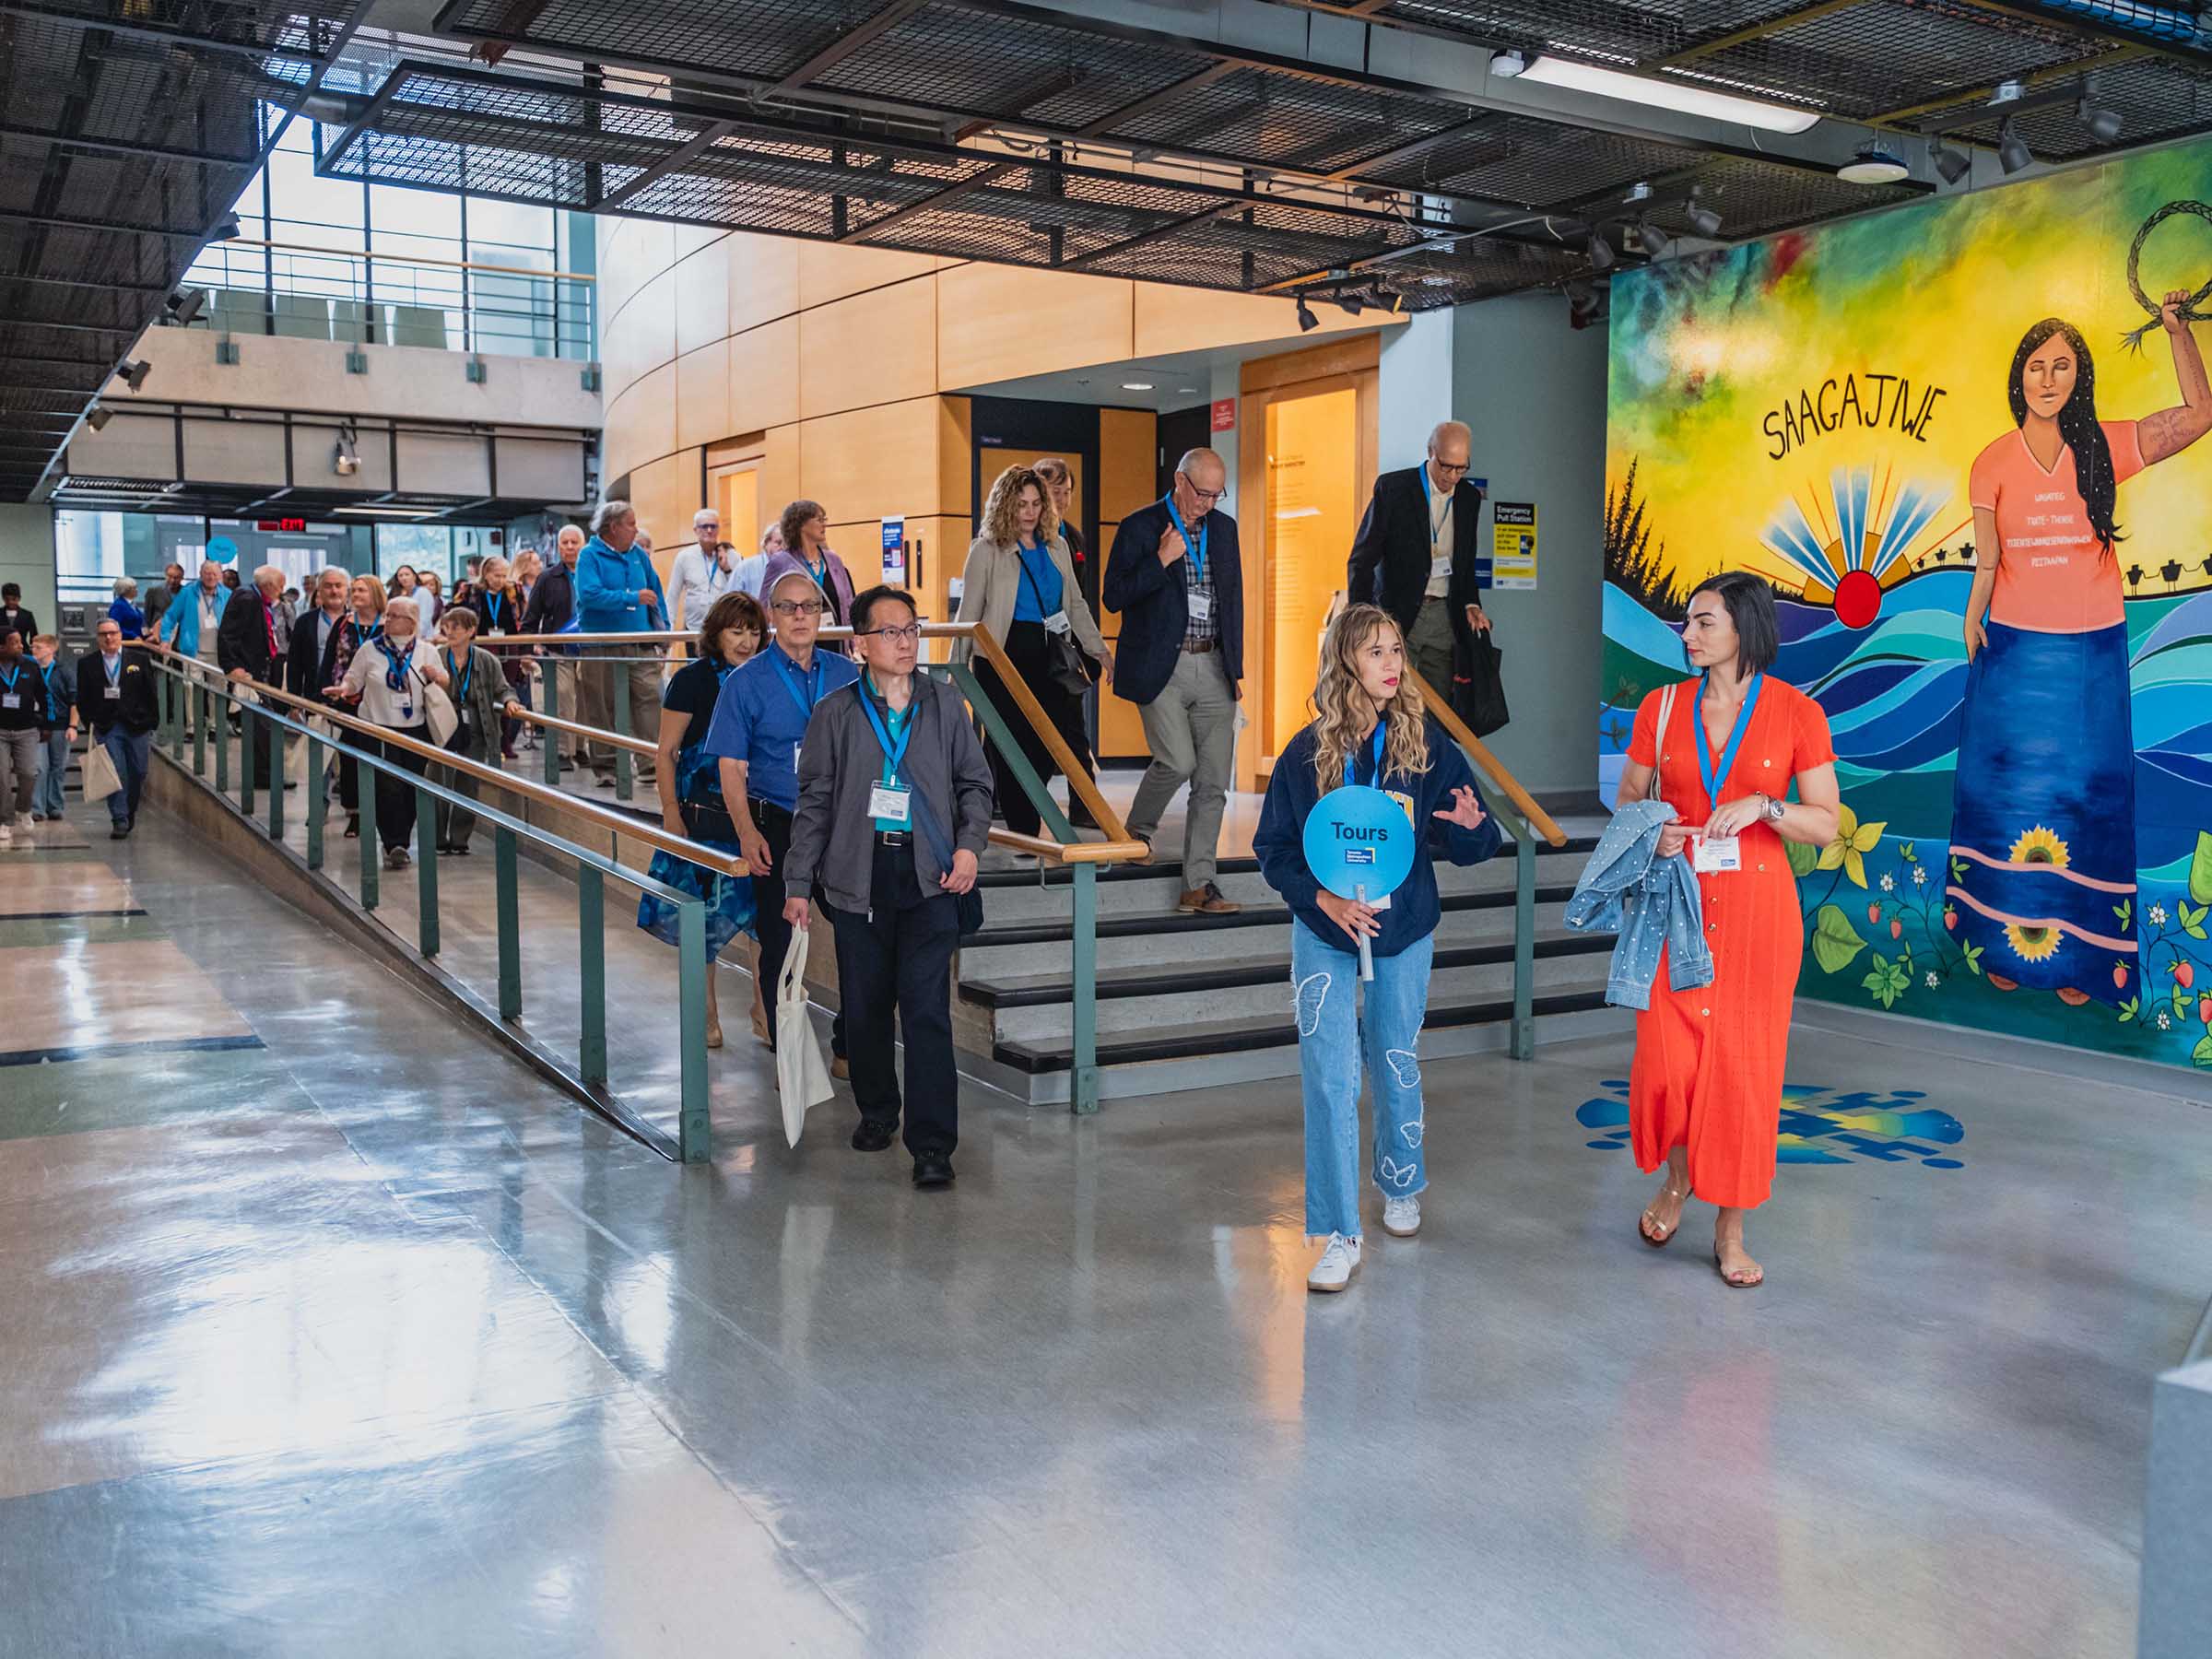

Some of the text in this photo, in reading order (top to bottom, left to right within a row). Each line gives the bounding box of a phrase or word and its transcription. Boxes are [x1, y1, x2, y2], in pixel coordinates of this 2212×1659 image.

[1763, 372, 1947, 461] SAAGAJIWE
[1497, 506, 1531, 515] Emergency
[280, 518, 305, 531] EXIT
[1330, 822, 1388, 841] Tours
